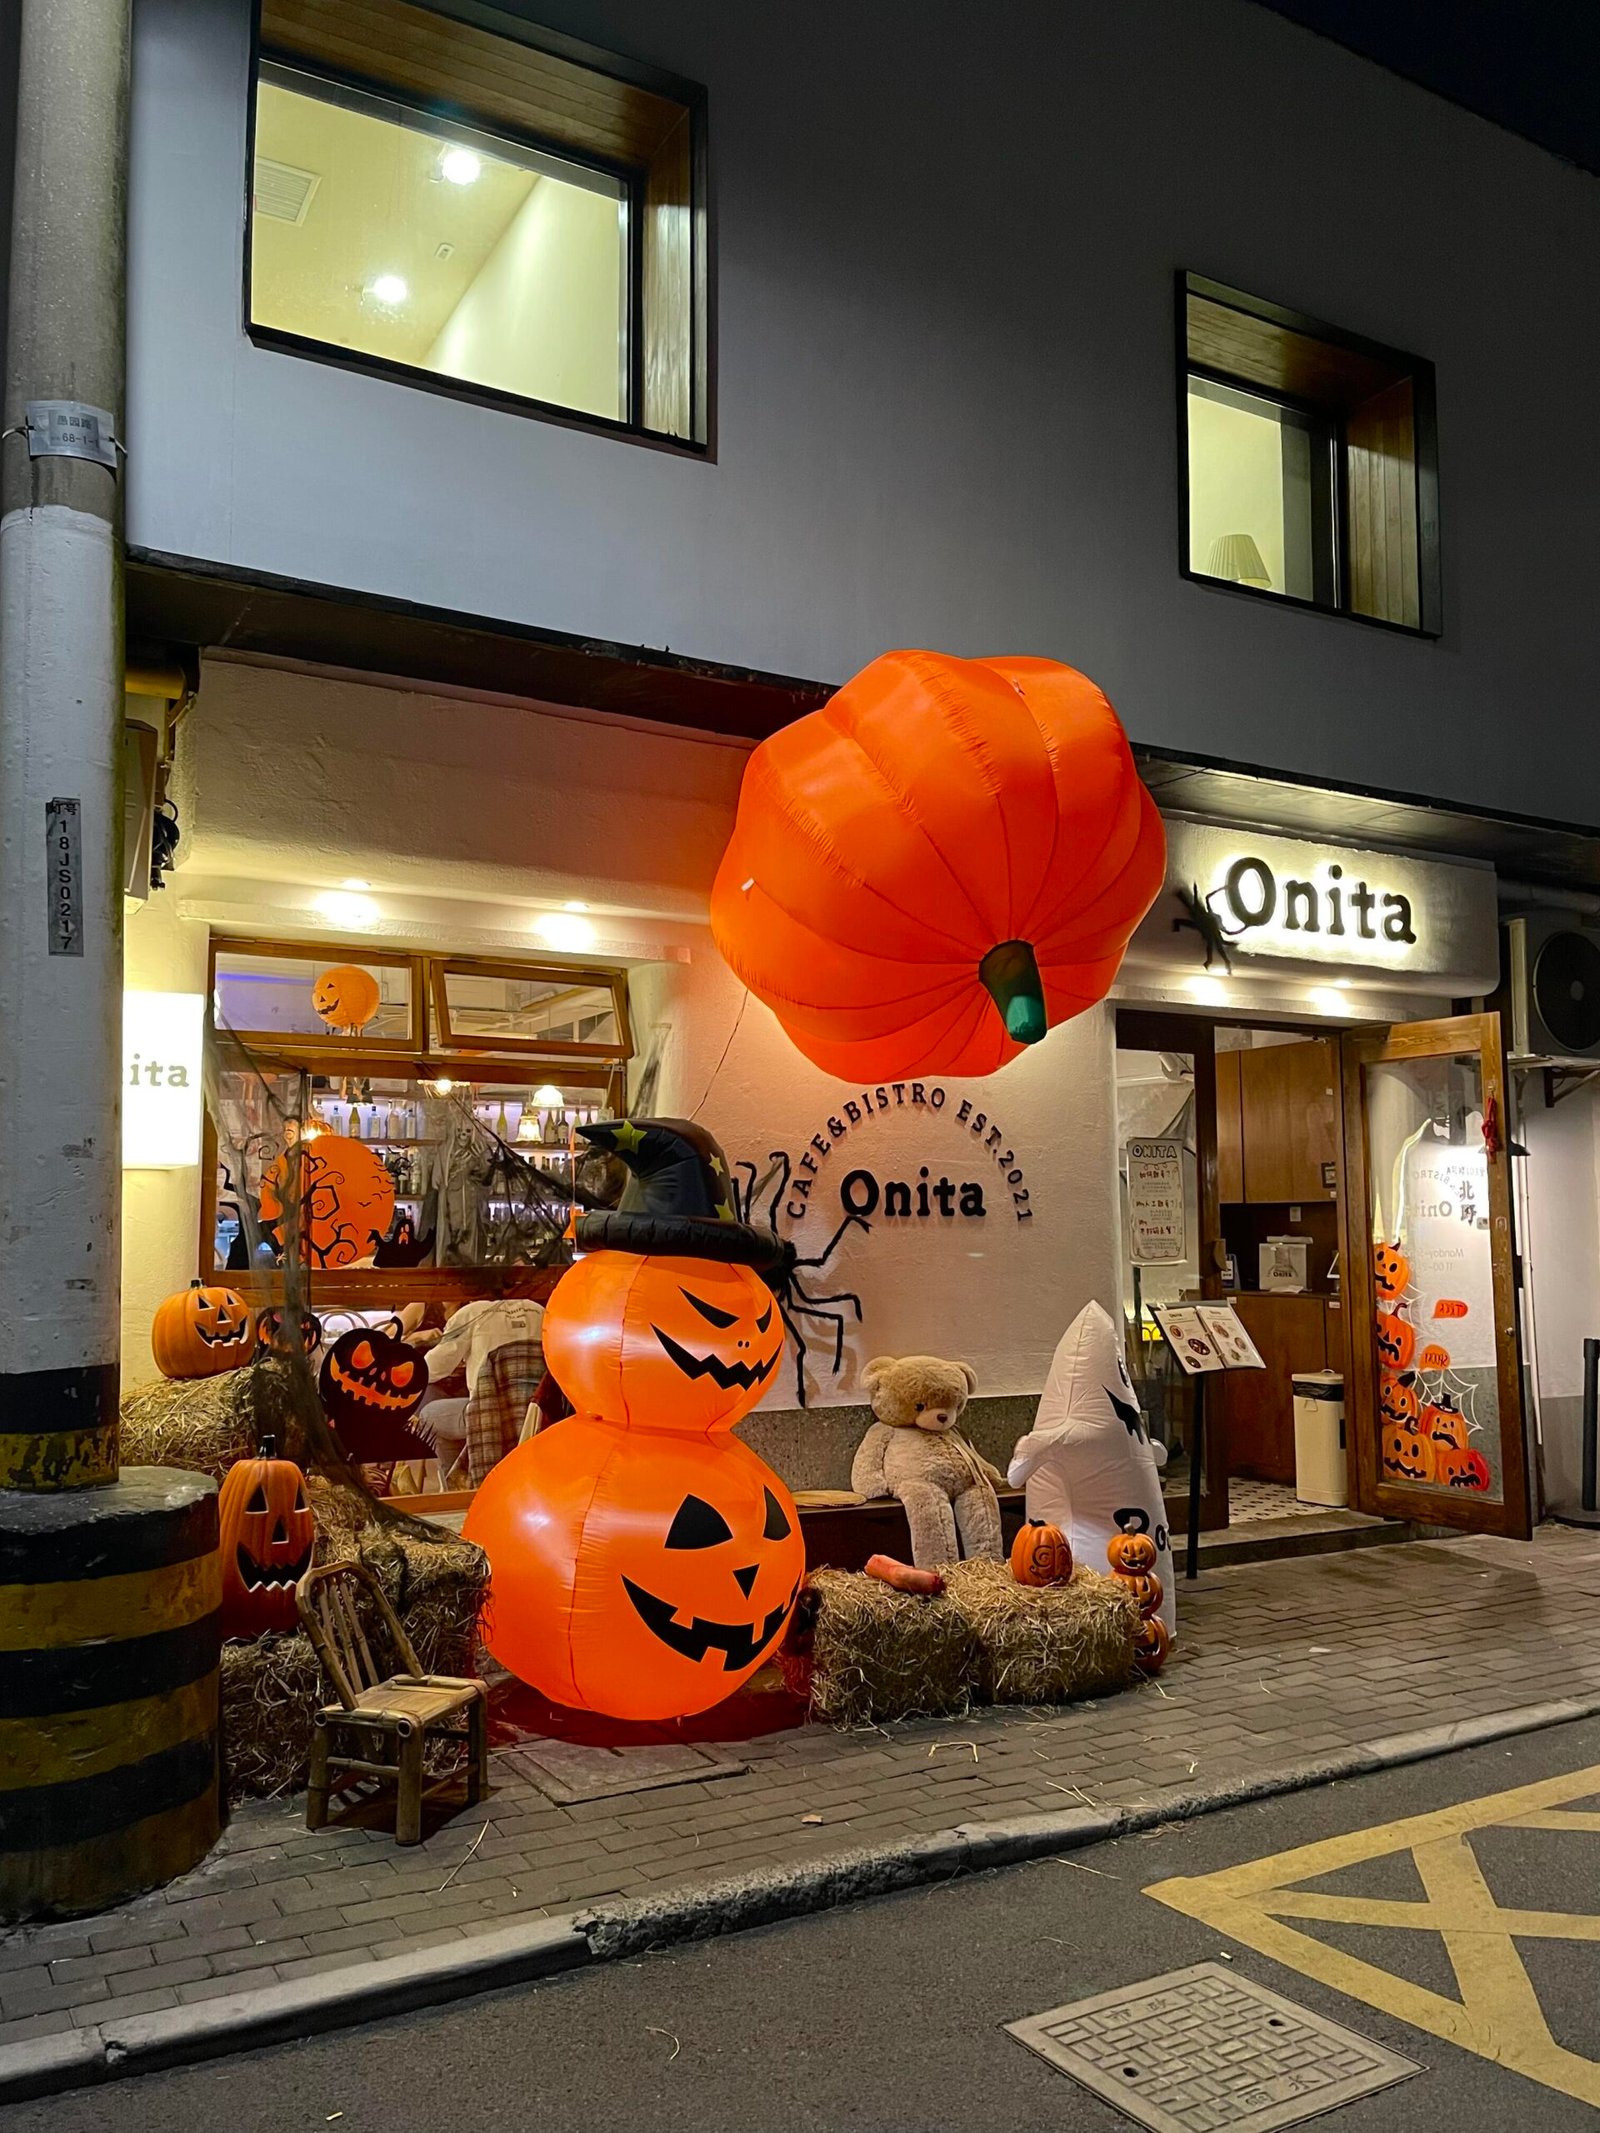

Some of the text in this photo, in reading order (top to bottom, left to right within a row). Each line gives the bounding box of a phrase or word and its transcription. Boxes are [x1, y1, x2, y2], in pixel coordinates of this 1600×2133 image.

[58, 819, 72, 949] 18JS0217
[1225, 857, 1417, 944] Onita
[129, 1053, 189, 1087] ita
[1132, 1144, 1177, 1158] ONITA
[840, 1166, 987, 1217] Onita
